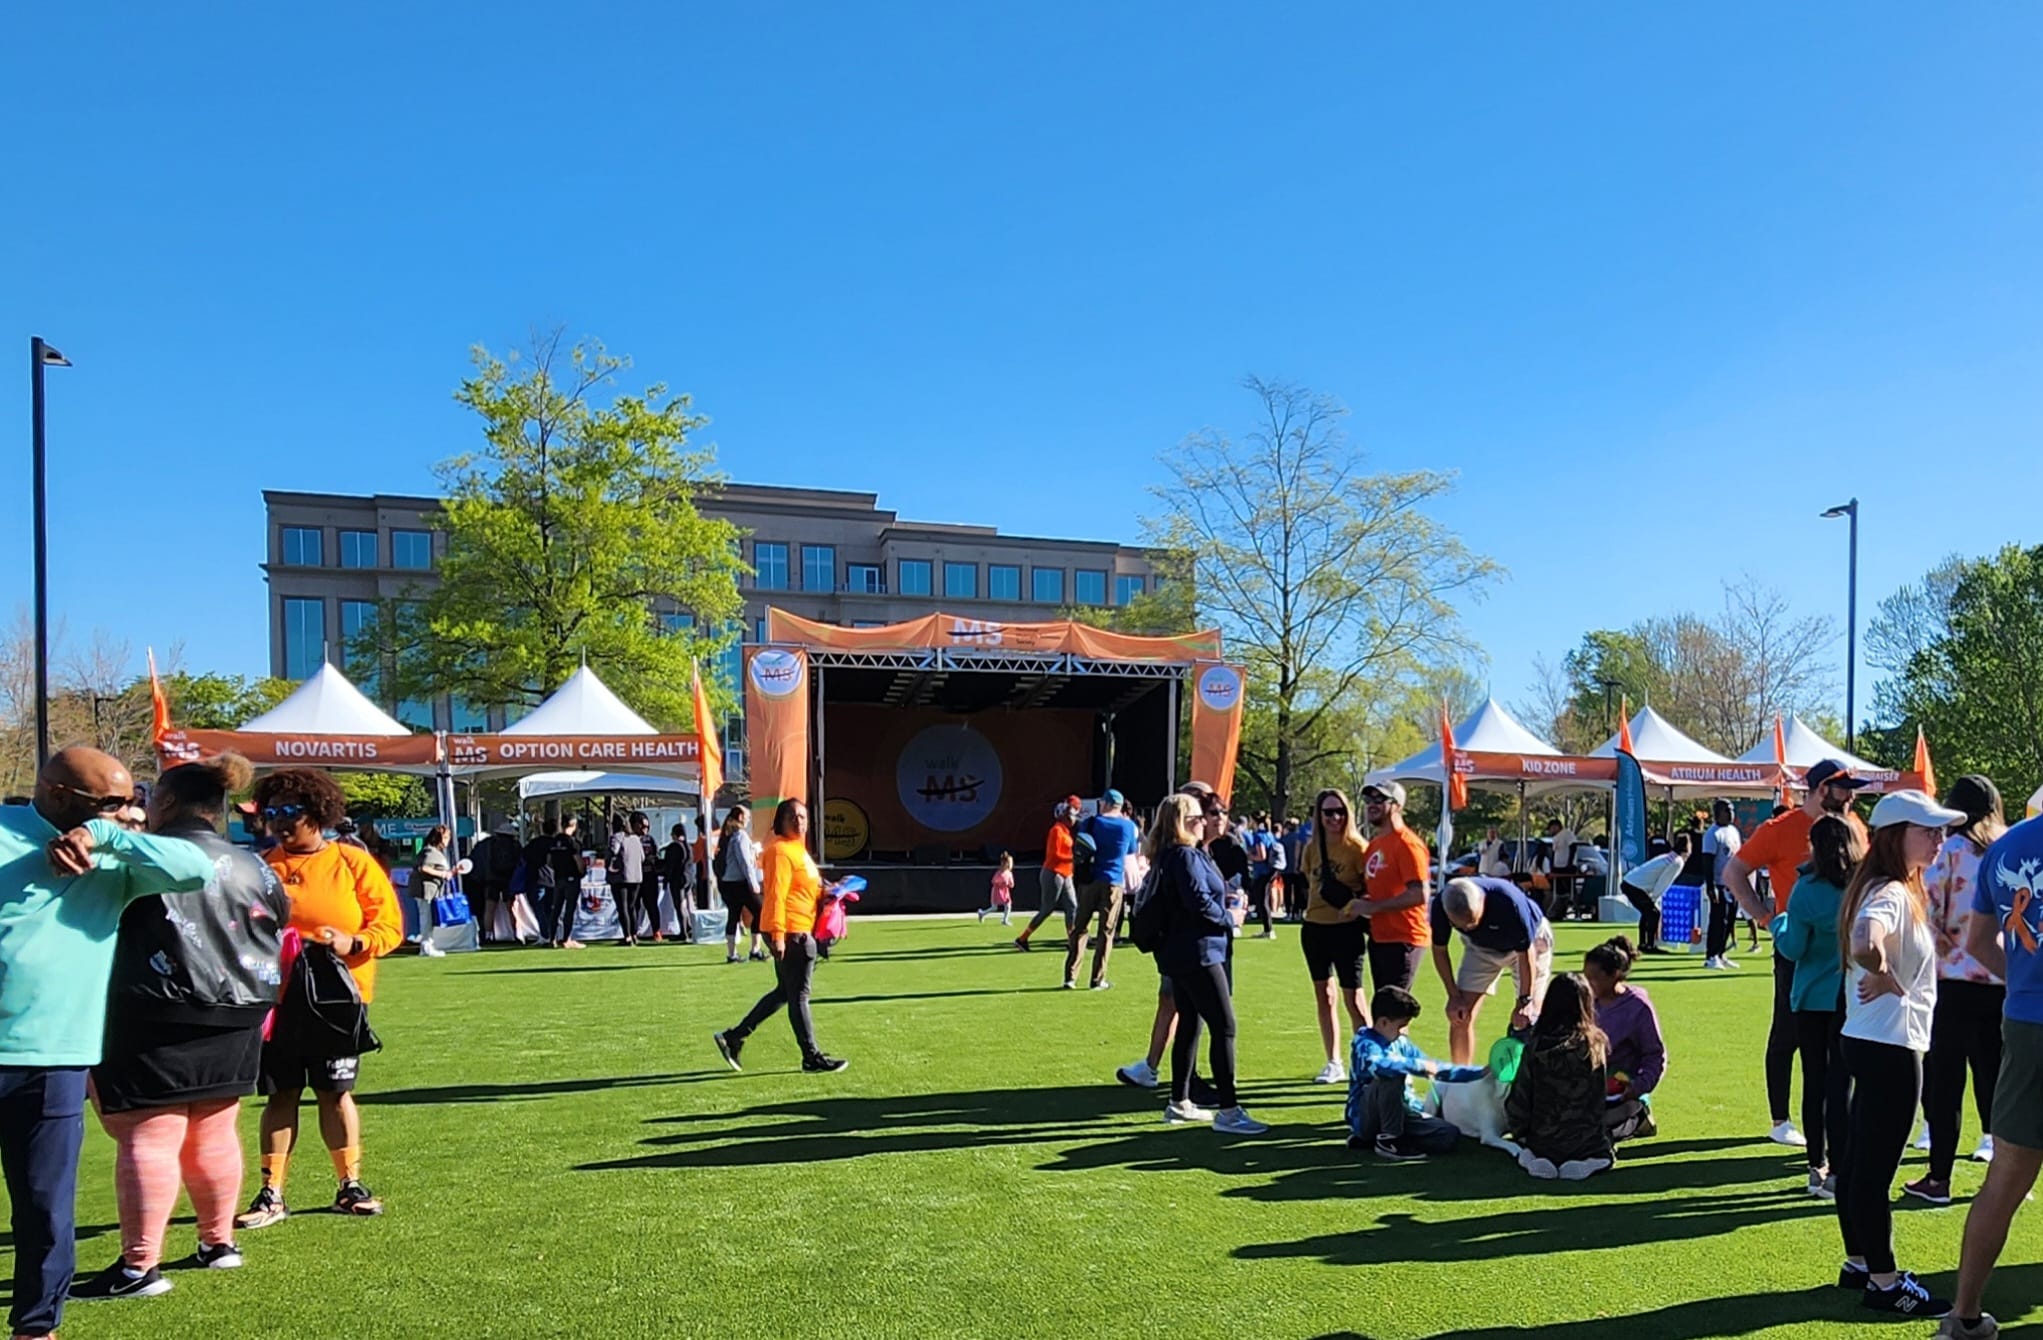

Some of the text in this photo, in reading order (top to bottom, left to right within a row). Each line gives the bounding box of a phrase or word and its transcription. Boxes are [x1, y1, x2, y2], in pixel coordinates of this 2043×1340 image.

[953, 618, 1003, 645] MS
[764, 668, 792, 681] MS
[452, 735, 476, 744] walk
[163, 742, 200, 759] MS
[275, 740, 377, 758] NOVARTIS
[455, 746, 488, 763] MS
[500, 741, 698, 758] OPTION CARE HEALTH
[924, 754, 959, 769] walk
[1522, 759, 1577, 775] KID ZONE
[1671, 767, 1761, 780] ATRIUM HEALTH
[925, 774, 978, 802] MS
